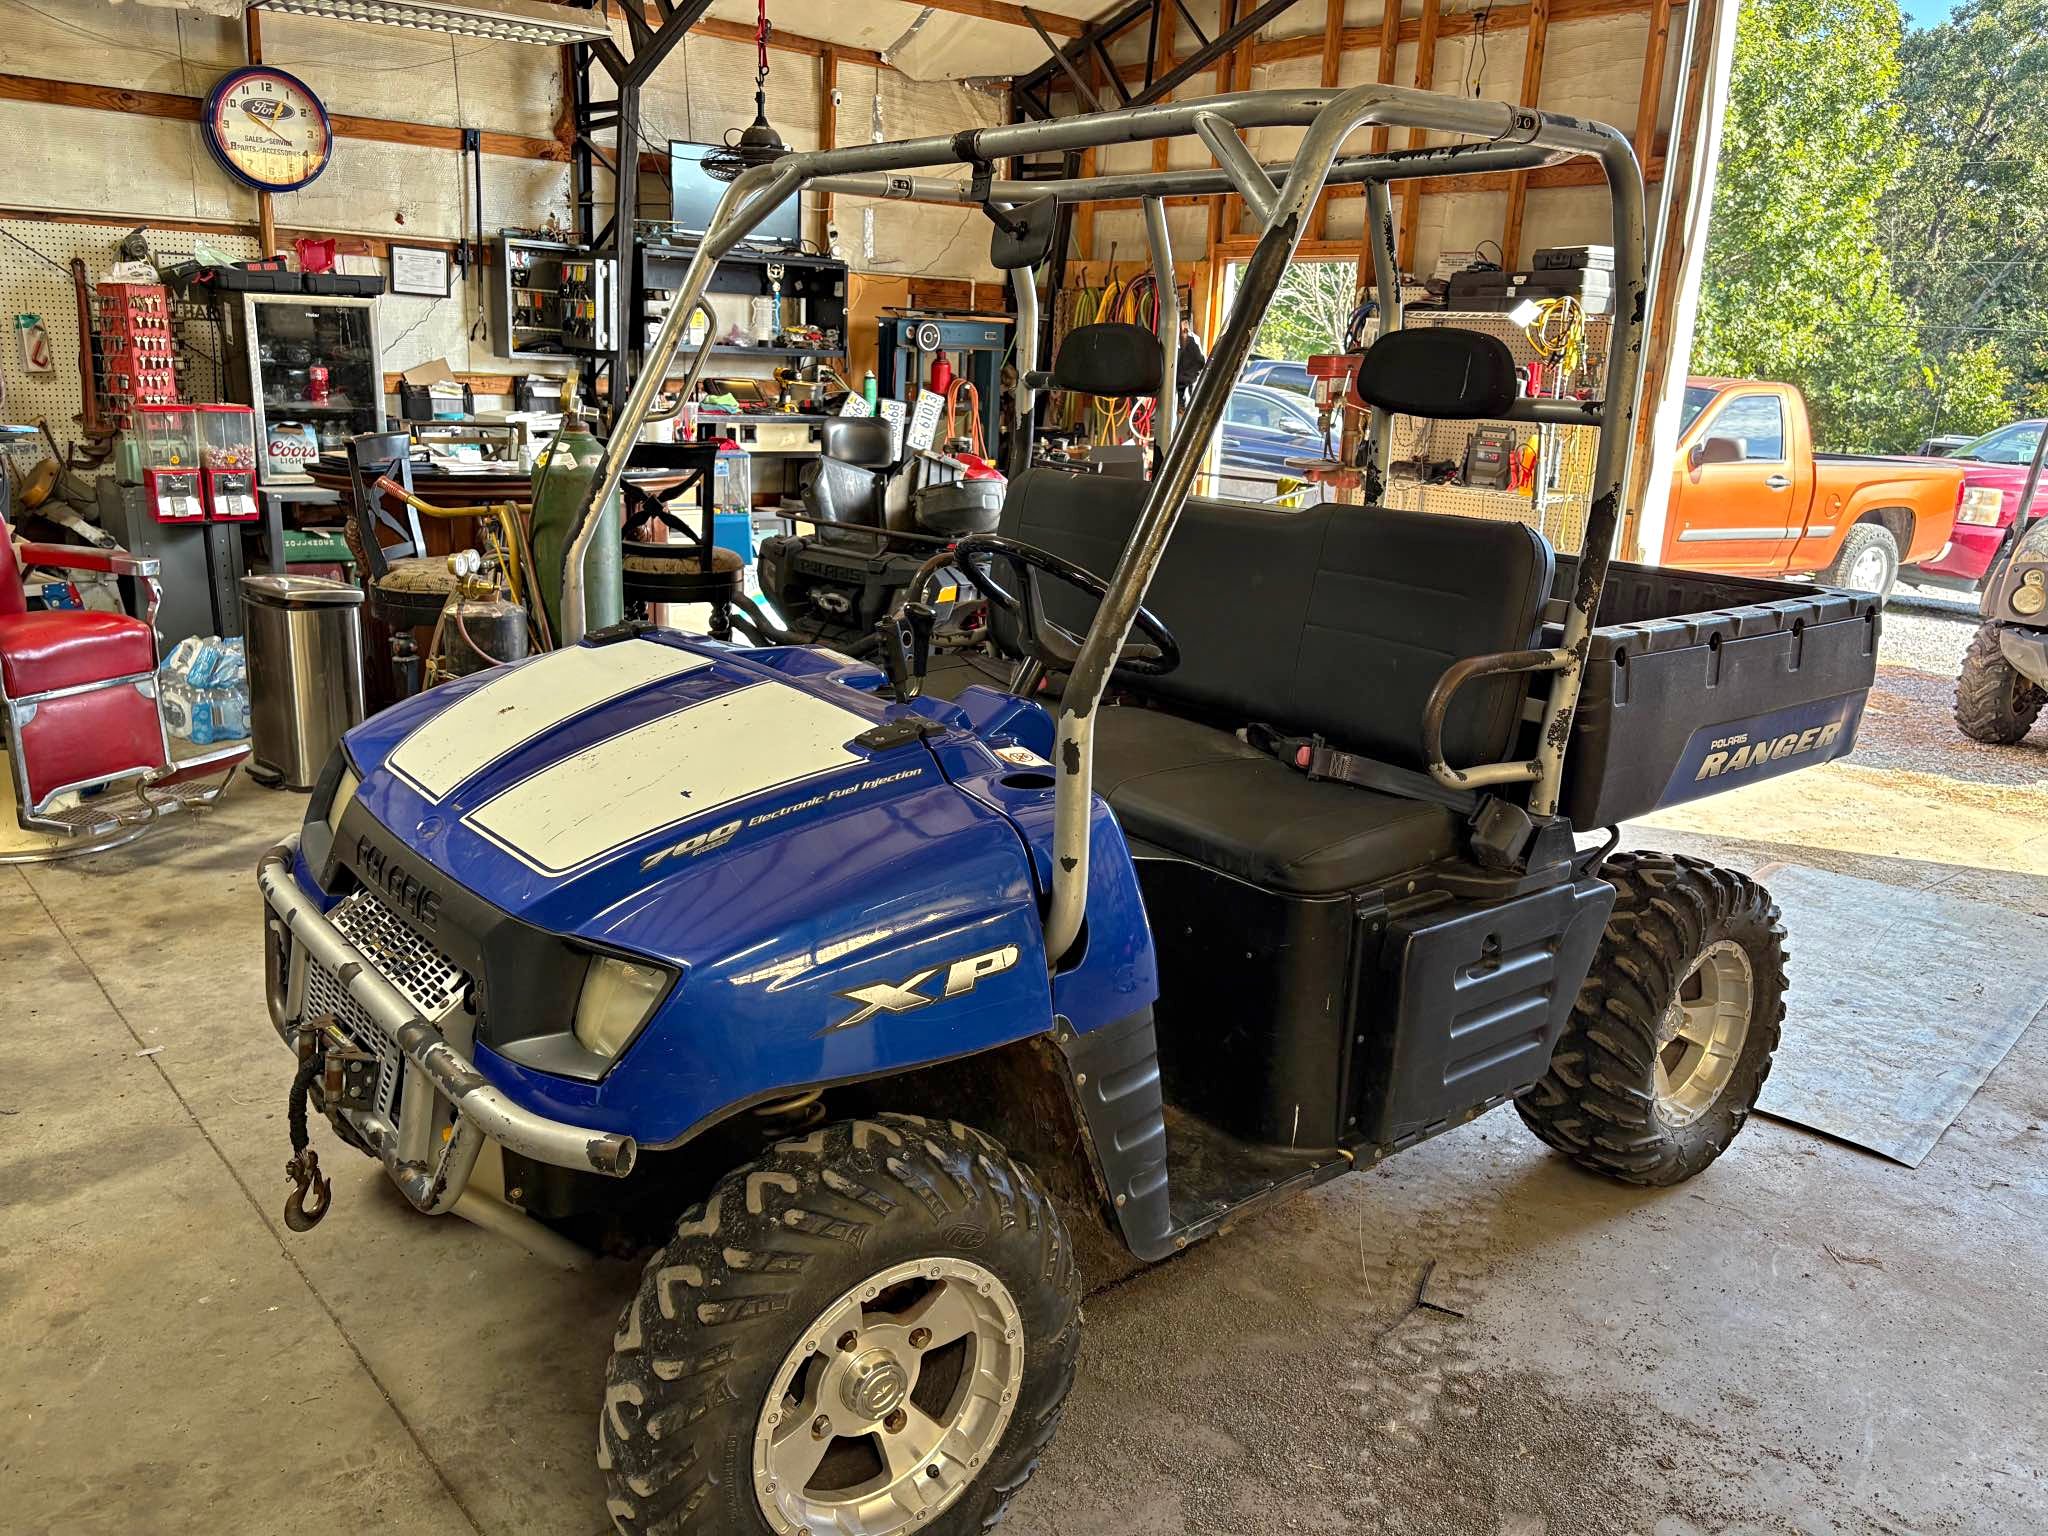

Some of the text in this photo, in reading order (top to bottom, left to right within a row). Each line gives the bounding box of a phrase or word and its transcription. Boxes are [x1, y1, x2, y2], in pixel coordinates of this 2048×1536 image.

[242, 86, 249, 94] 11
[261, 82, 272, 91] 12
[286, 91, 289, 99] 1
[226, 99, 236, 108] 10
[300, 109, 307, 117] 2
[223, 120, 230, 129] 9
[244, 135, 263, 143] SALES
[307, 131, 314, 139] 3
[302, 150, 309, 158] 4
[246, 159, 253, 168] 7
[920, 394, 938, 429] 61013
[269, 441, 316, 457] Coors
[1711, 733, 1749, 750] POLARIS
[1695, 720, 1842, 781] RANGER
[640, 819, 743, 872] 700
[748, 793, 826, 827] Electronic
[827, 784, 859, 800] Fuel
[861, 768, 922, 789] Injection
[357, 835, 442, 923] POLARIS
[832, 944, 1021, 1028] XP
